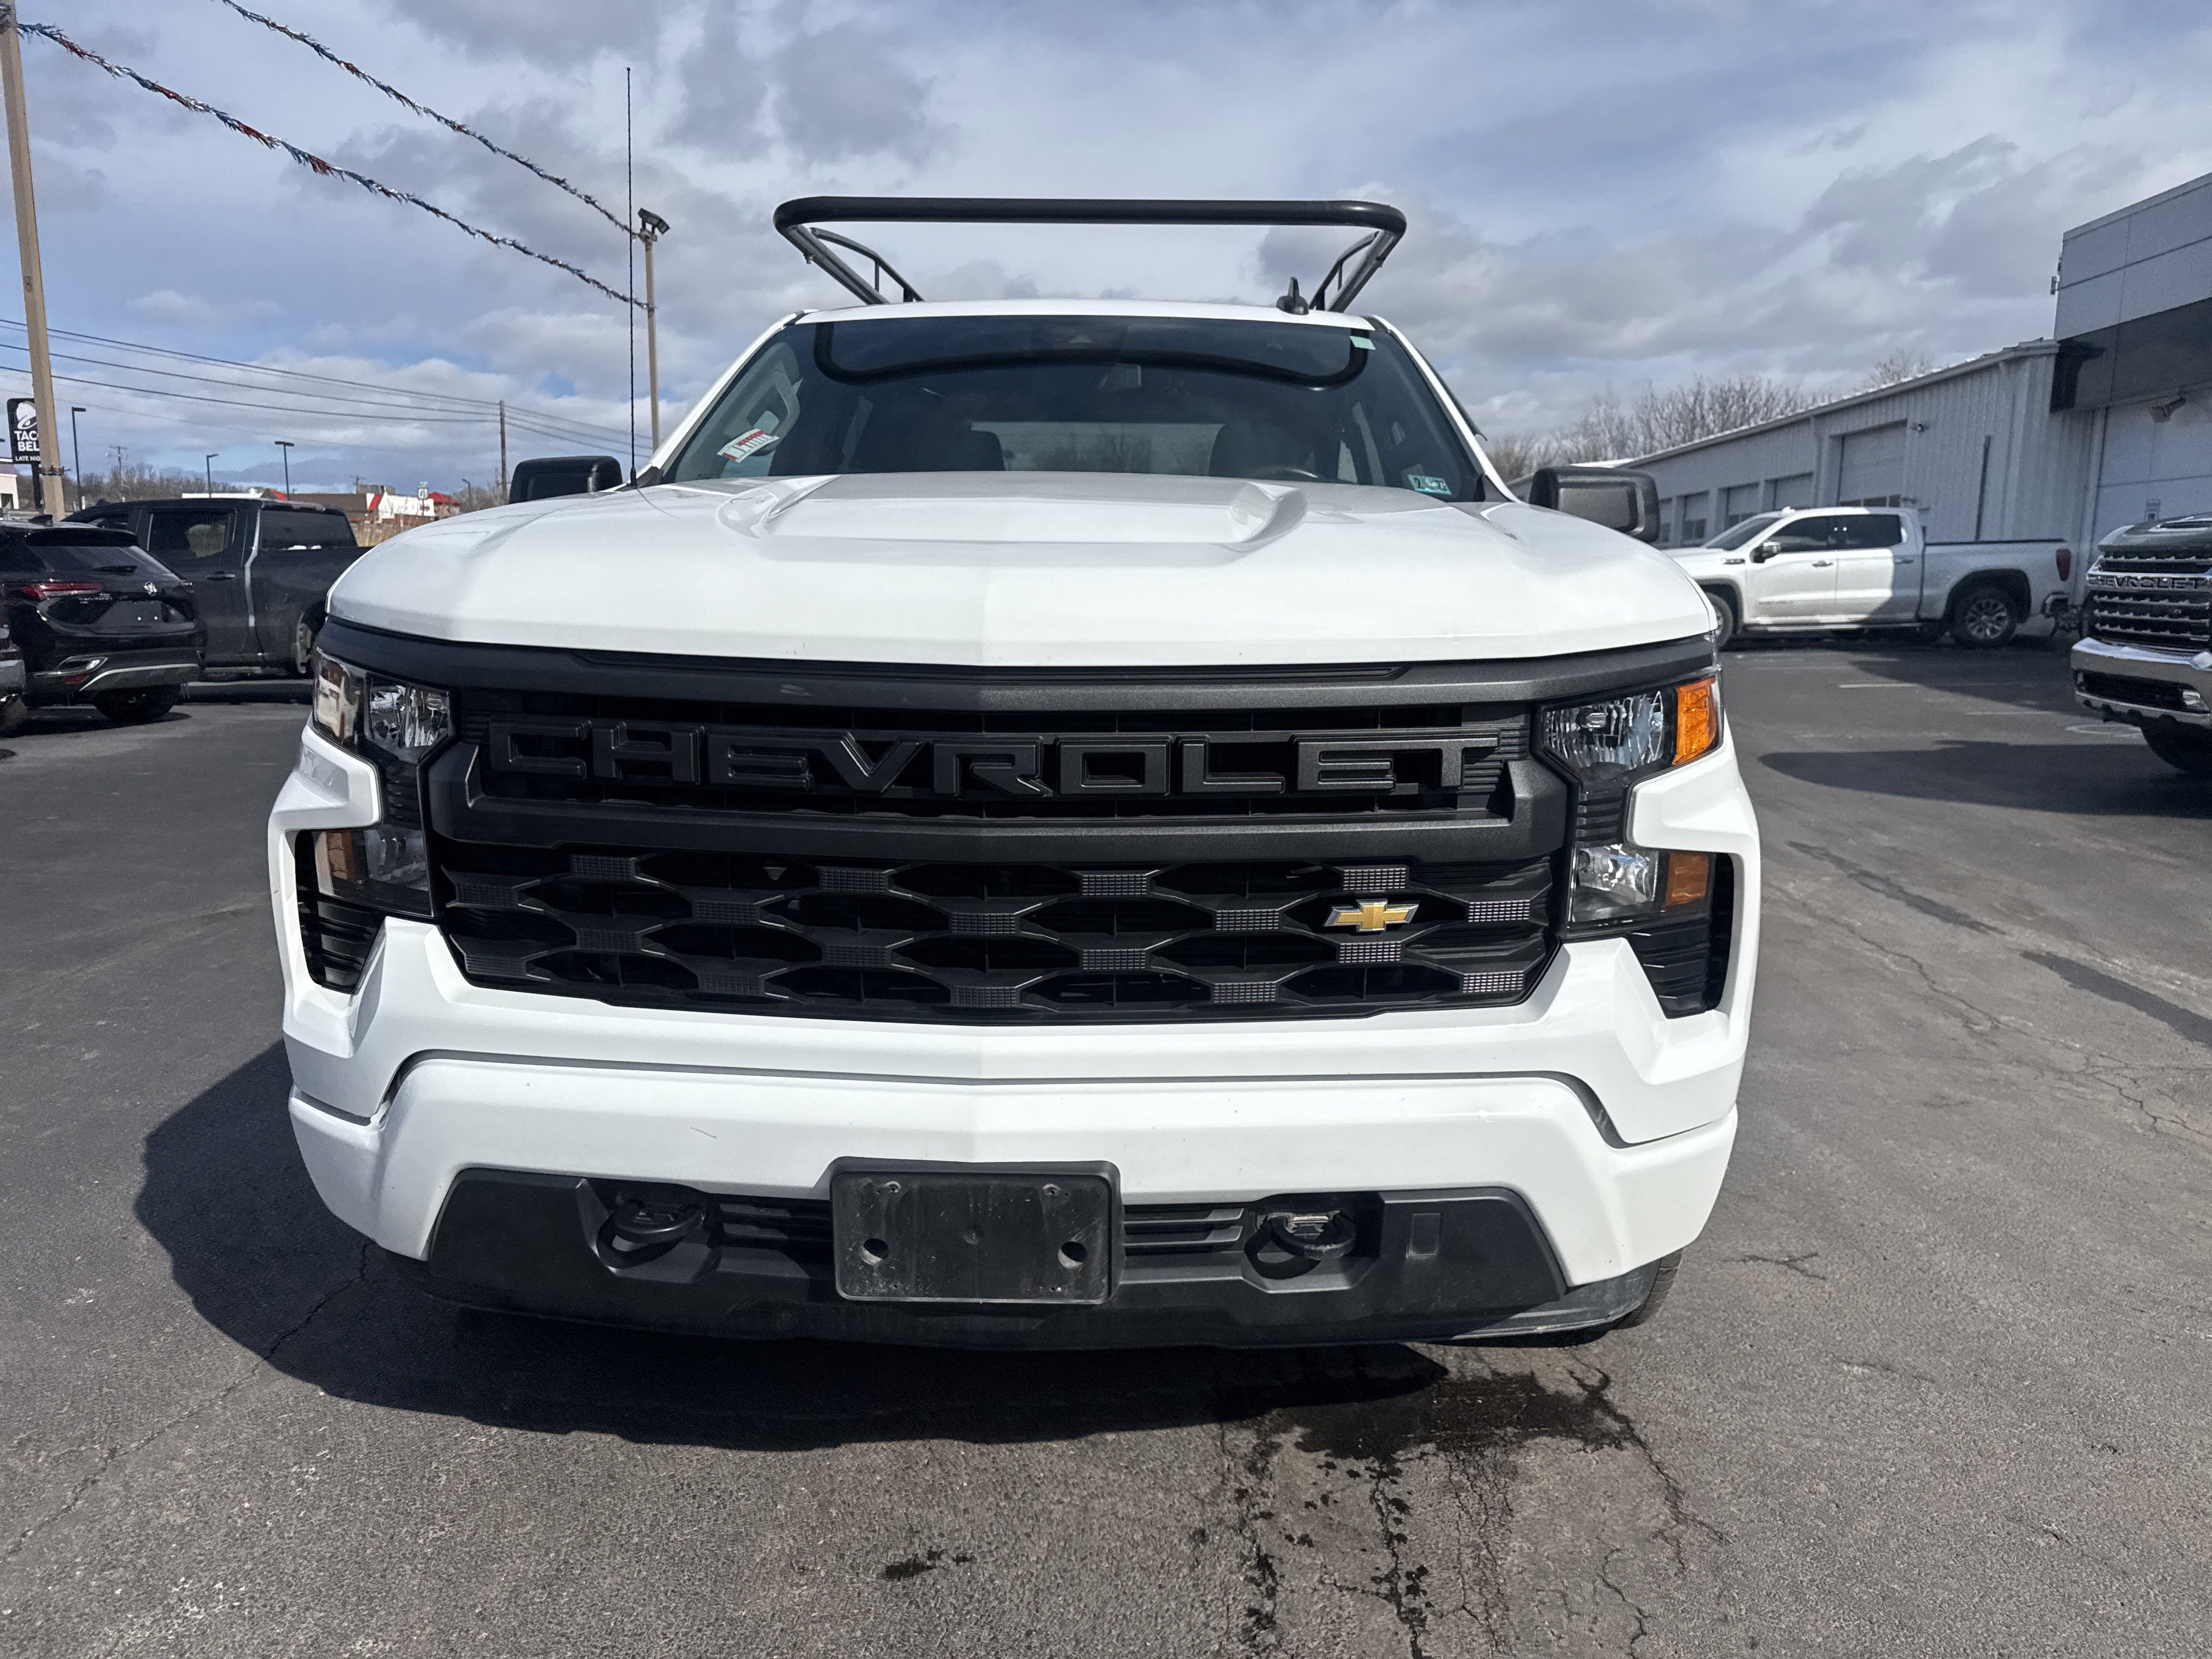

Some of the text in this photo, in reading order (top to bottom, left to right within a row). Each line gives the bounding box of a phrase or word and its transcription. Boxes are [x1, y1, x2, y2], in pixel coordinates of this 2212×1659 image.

[14, 430, 38, 441] TAC
[18, 441, 40, 452] BEL
[2087, 575, 2199, 590] CHEVROLET
[489, 719, 1500, 797] CHEVROLET
